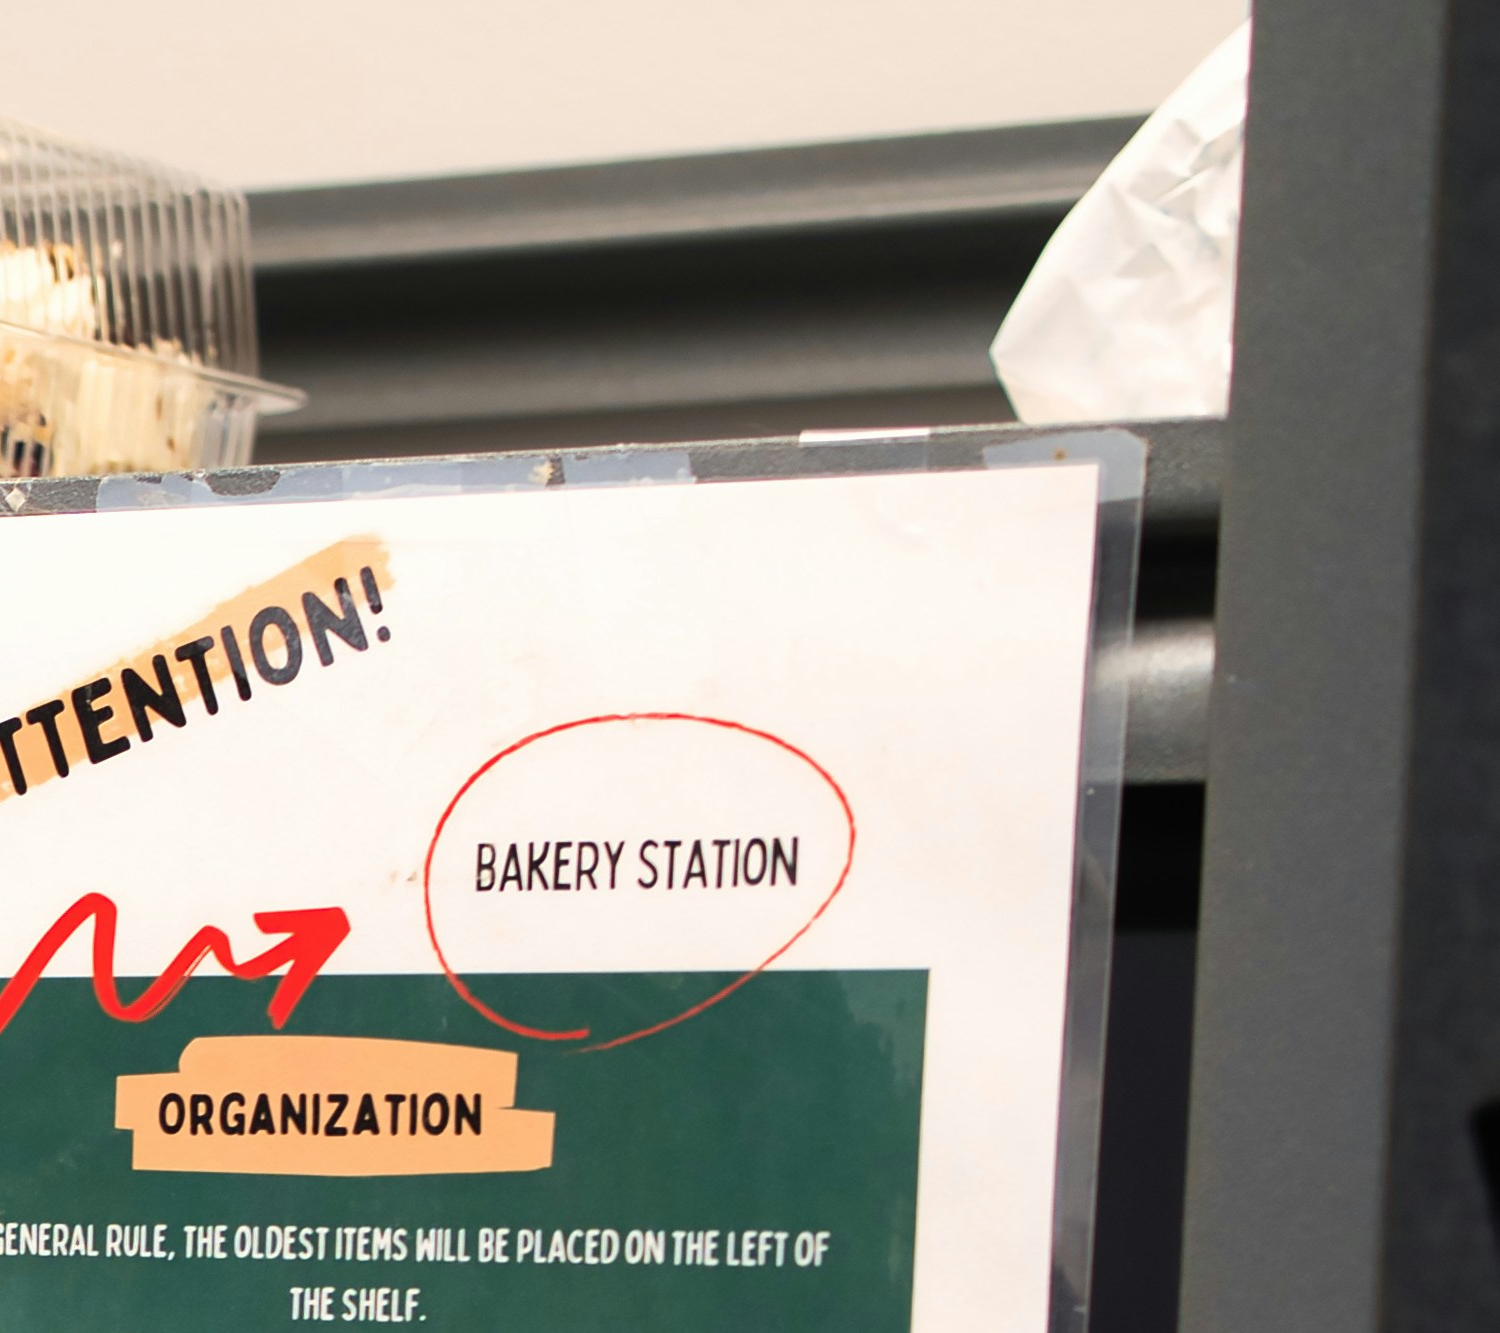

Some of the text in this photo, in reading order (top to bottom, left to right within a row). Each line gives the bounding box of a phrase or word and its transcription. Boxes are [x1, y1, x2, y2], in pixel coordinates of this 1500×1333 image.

[474, 836, 800, 891] BAKERY STATION
[159, 1092, 481, 1136] ORGANIZATION
[106, 1224, 175, 1261] RULE,
[183, 1225, 228, 1259] THE
[234, 1225, 329, 1260] OLDEST
[335, 1226, 408, 1261] ITEMS
[416, 1228, 470, 1262] WILL
[478, 1227, 510, 1263] BE
[517, 1229, 620, 1265] PLACED
[625, 1230, 665, 1264] ON
[672, 1230, 719, 1266] THE
[726, 1230, 788, 1266] LEFT
[795, 1231, 830, 1266] OF
[289, 1286, 427, 1322] THE SHELF.
